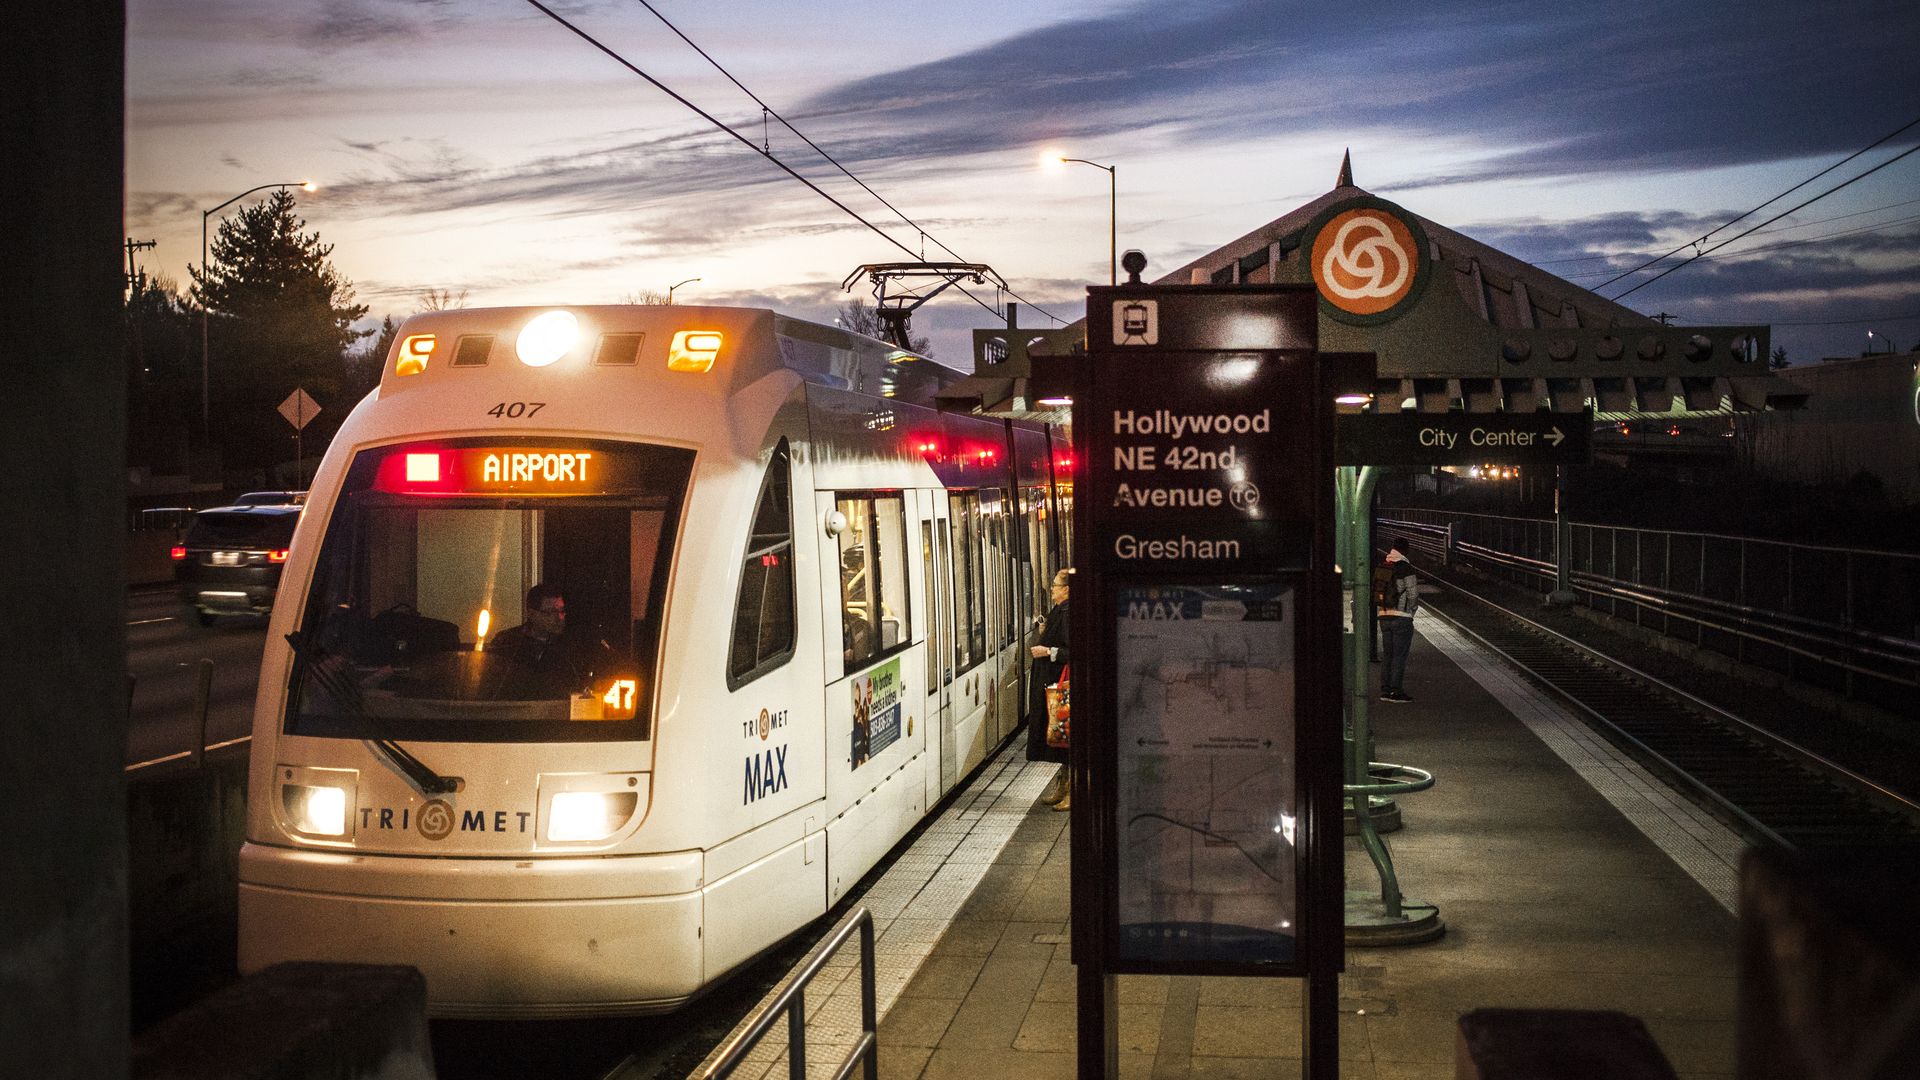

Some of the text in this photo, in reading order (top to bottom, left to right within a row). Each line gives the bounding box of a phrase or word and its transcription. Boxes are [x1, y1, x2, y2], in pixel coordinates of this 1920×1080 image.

[487, 402, 546, 418] 407
[1114, 409, 1270, 439] Hollywood
[1419, 428, 1536, 449] City Center
[484, 453, 591, 481] AIRPORT
[1114, 445, 1236, 470] NE 42nd
[1114, 483, 1257, 507] Avenue TC
[1115, 535, 1240, 559] Gresham
[1128, 601, 1185, 621] MAX
[603, 680, 636, 710] 47
[743, 710, 788, 739] TRI MET
[744, 744, 788, 805] MAX
[360, 808, 531, 833] TRI MET
